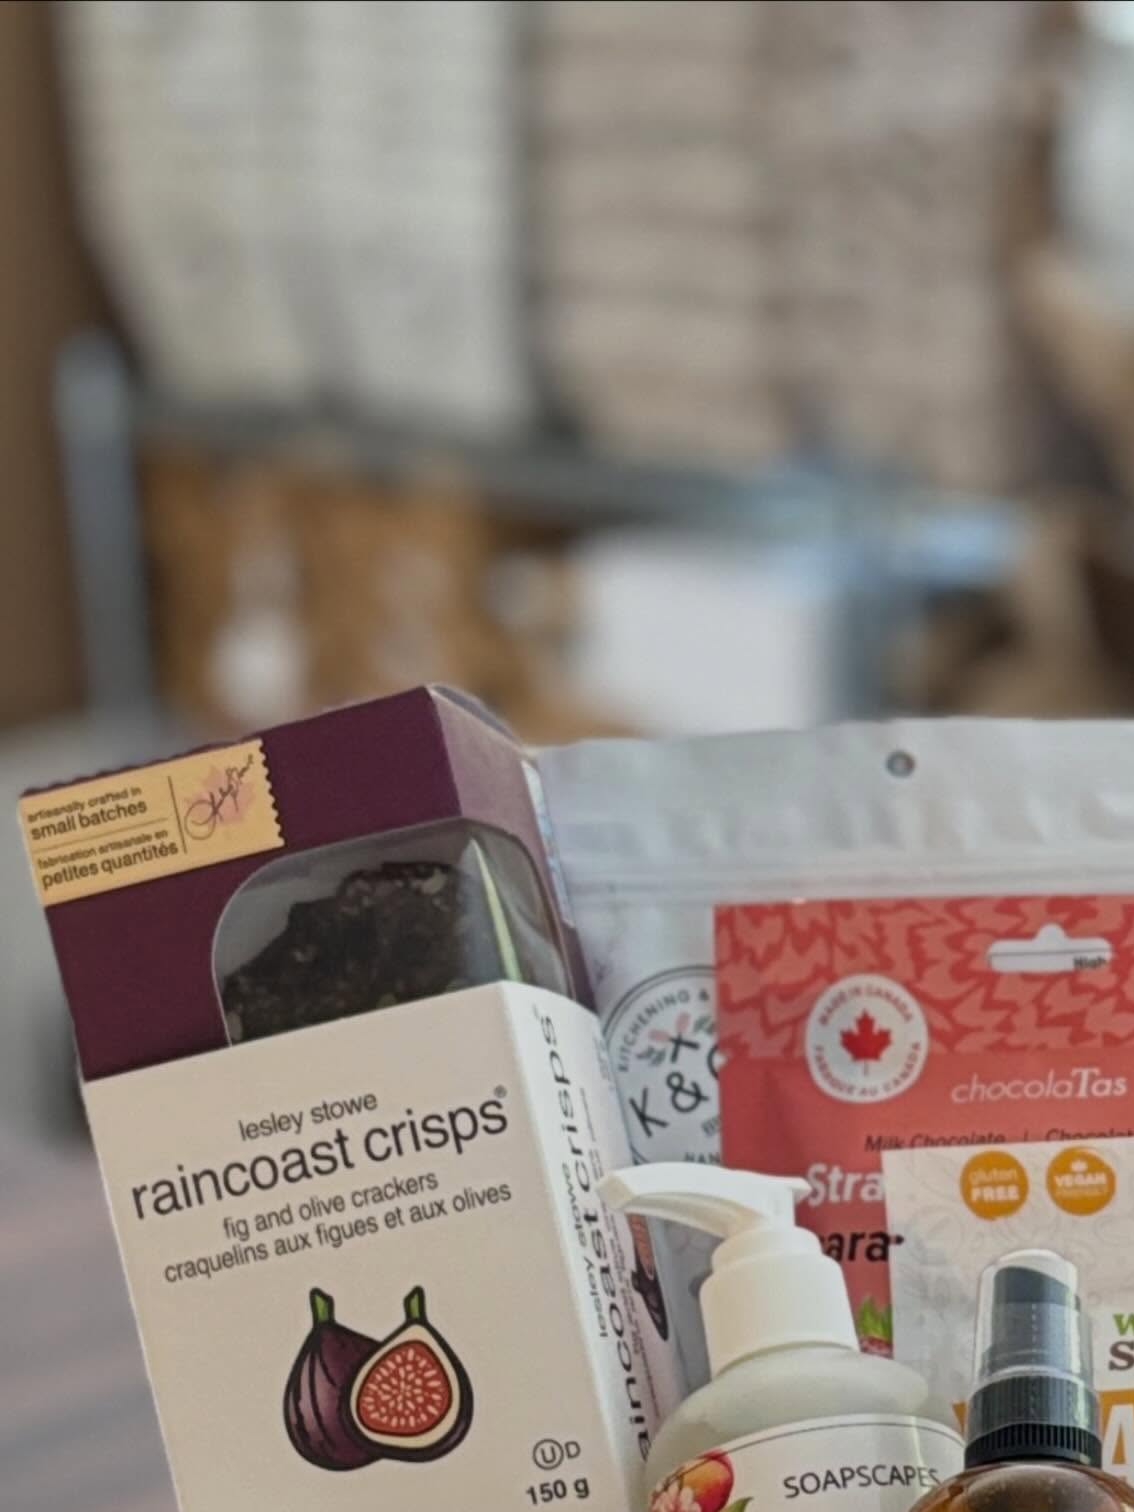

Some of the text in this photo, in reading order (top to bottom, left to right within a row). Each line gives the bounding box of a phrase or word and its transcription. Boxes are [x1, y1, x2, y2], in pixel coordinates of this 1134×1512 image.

[28, 786, 141, 823] artisanally crafted in
[31, 800, 147, 842] small batches
[38, 830, 168, 870] fabrication artisanale en
[42, 840, 178, 890] petites quantités
[538, 1010, 591, 1193] crisps
[952, 1066, 1128, 1103] chocolaTas
[238, 1091, 378, 1143] lesley stowe
[131, 1126, 356, 1221] raincoast
[807, 1162, 885, 1208] Stra
[969, 1168, 1018, 1187] gluten
[970, 1184, 1021, 1204] FREE
[1053, 1171, 1109, 1188] VEGAN
[223, 1171, 439, 1243] fig and olive crackers
[164, 1180, 512, 1283] craquelins aux figues et aux olives
[526, 1477, 590, 1506] 150 g
[783, 1464, 941, 1500] SOAPSCAPES
